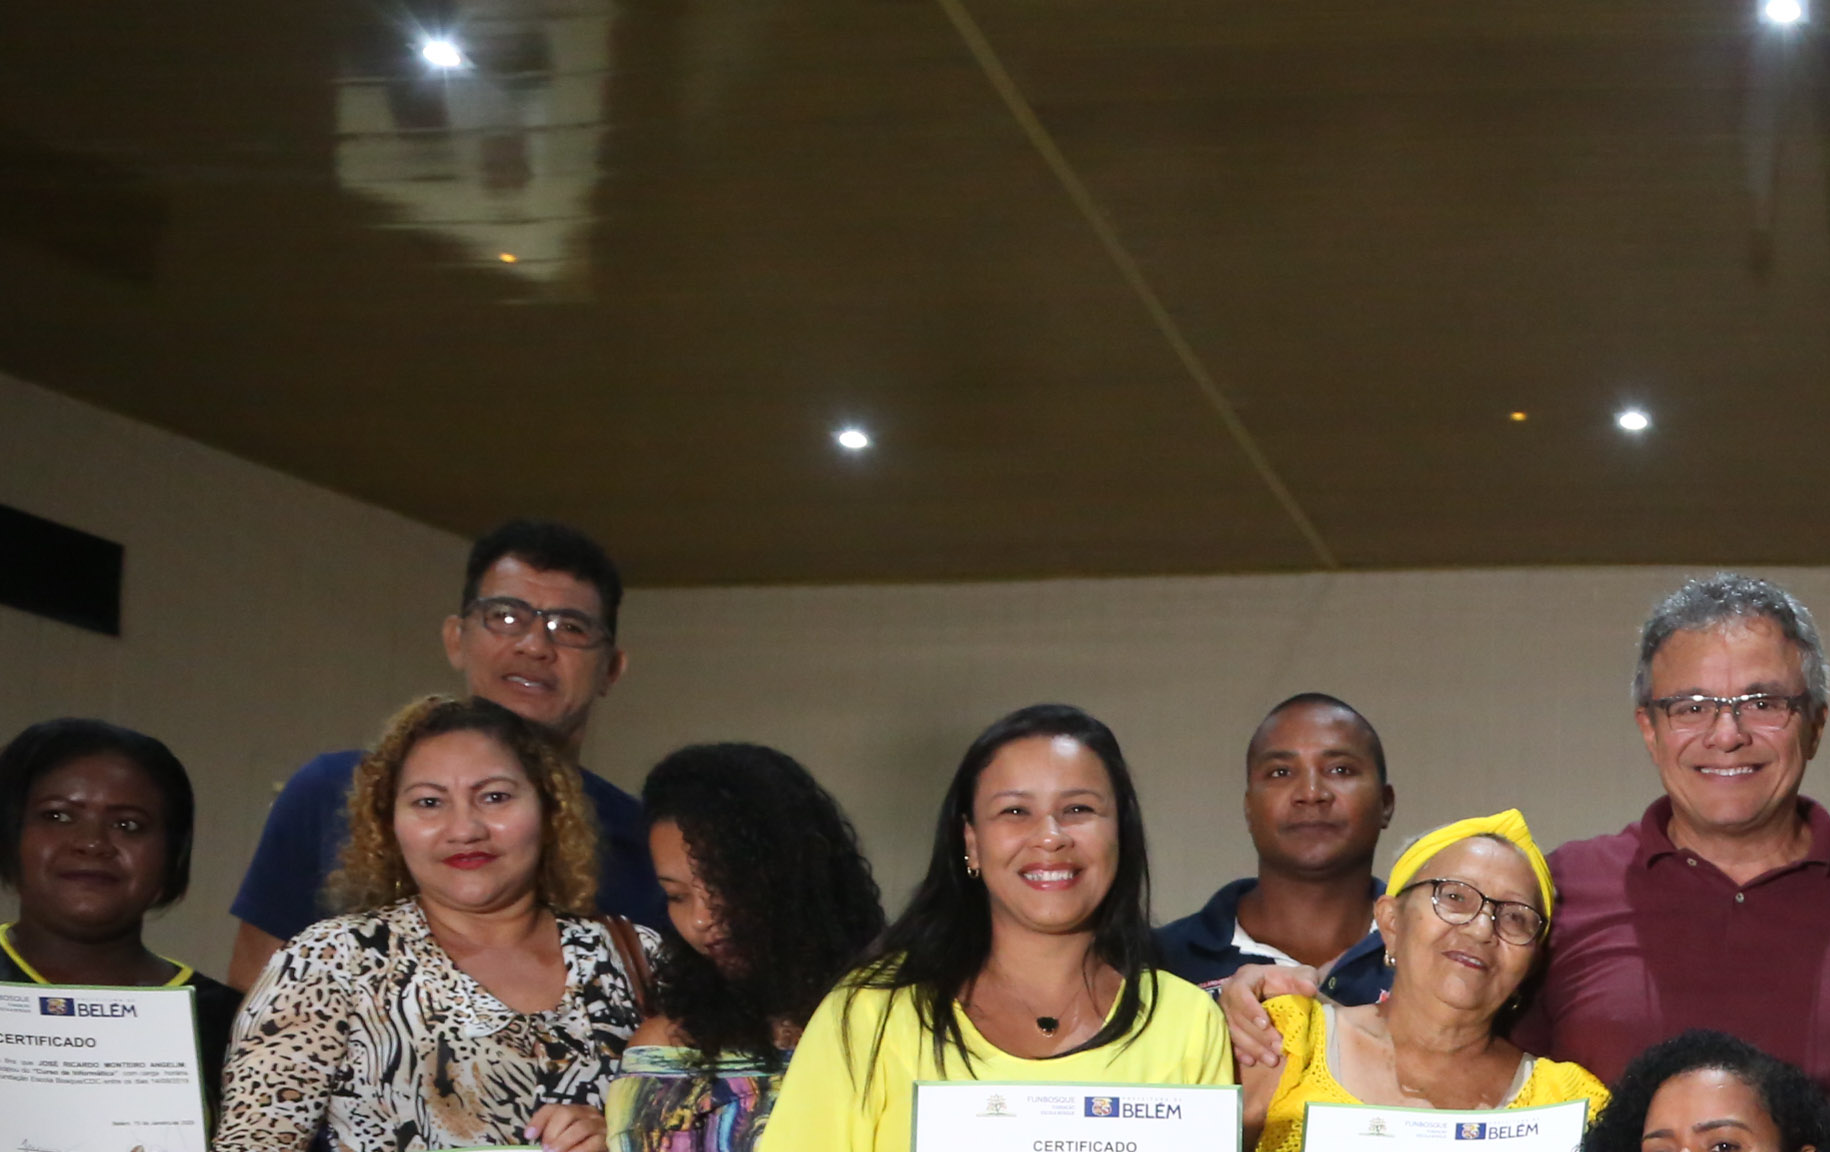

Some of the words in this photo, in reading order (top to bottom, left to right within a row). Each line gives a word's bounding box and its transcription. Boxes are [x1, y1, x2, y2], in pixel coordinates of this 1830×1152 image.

[77, 1002, 137, 1017] BELÉM
[1122, 1102, 1181, 1119] BELÉM
[1488, 1122, 1538, 1139] BELÉM
[1032, 1140, 1137, 1152] CERTIFICADO
